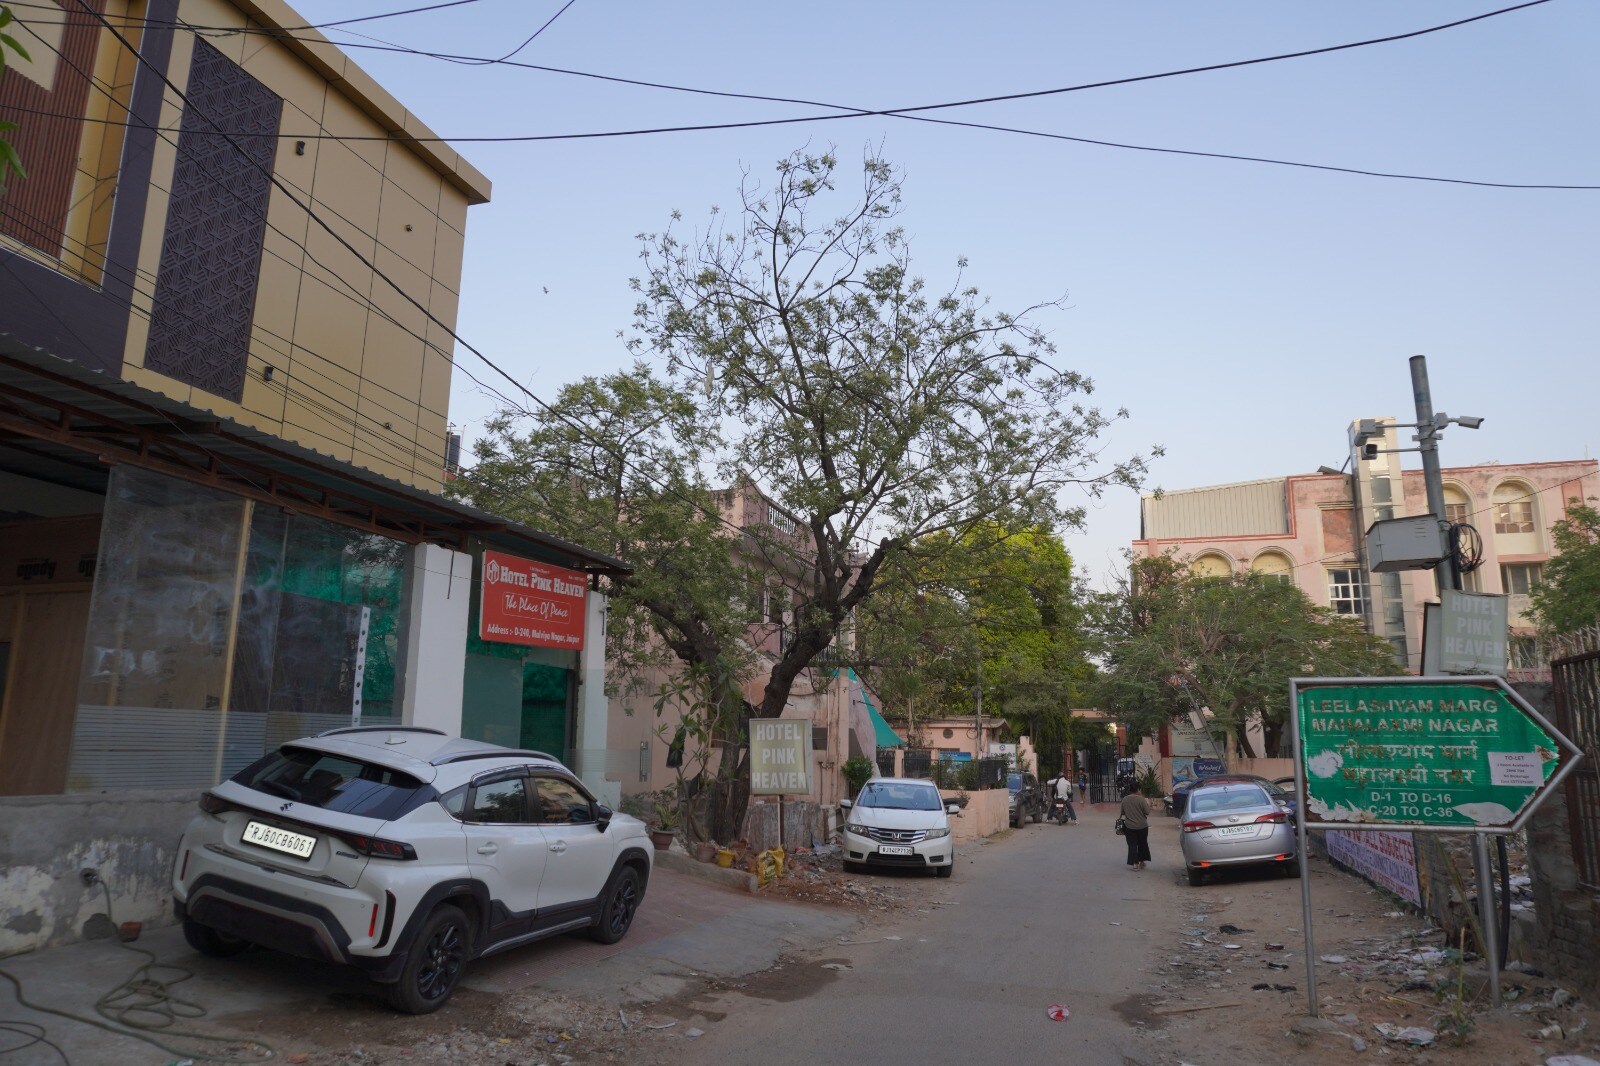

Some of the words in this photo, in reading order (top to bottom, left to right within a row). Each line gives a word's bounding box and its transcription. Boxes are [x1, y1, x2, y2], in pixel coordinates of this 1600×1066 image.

[500, 566, 529, 588] HOTEL
[530, 573, 552, 591] PINK
[554, 578, 584, 598] HEAVEN
[506, 594, 517, 610] The
[518, 597, 538, 612] Place
[540, 602, 548, 619] Of
[550, 602, 568, 618] Peace
[1452, 595, 1499, 616] HOTEL
[487, 624, 509, 635] Address
[1456, 617, 1493, 636] PINK
[1445, 636, 1503, 658] HEAVEN
[1439, 700, 1498, 714] MARG
[756, 723, 801, 741] HOTEL
[1312, 718, 1423, 732] MAHALAXMI
[1429, 718, 1500, 733] NAGAR
[762, 747, 795, 764] PINK
[752, 772, 806, 789] HEAVEN
[1371, 792, 1391, 802] D-1
[1399, 792, 1418, 803] TO
[1422, 793, 1452, 804] D-16
[1401, 806, 1419, 817] TO
[1423, 806, 1453, 817] C-36
[251, 826, 312, 854] RJ60CB6061
